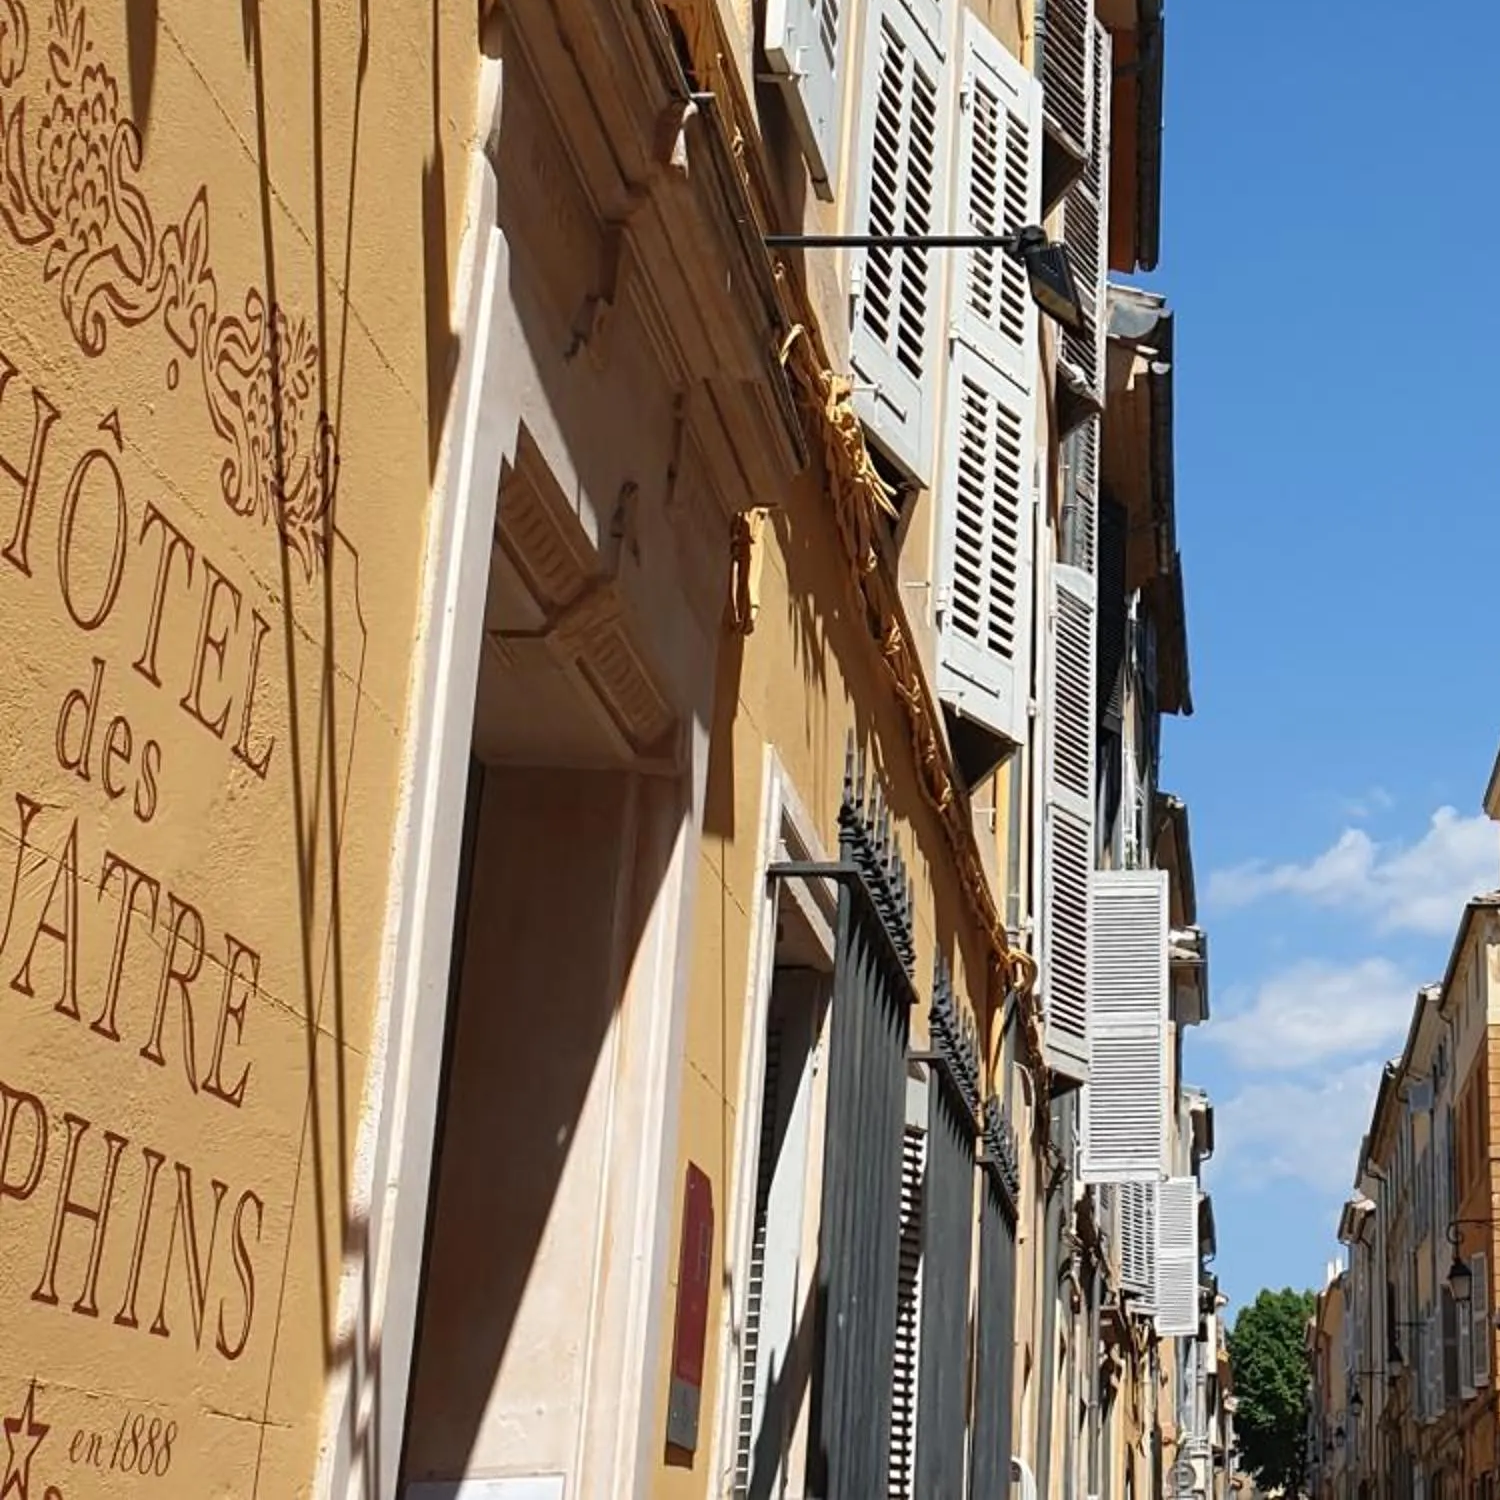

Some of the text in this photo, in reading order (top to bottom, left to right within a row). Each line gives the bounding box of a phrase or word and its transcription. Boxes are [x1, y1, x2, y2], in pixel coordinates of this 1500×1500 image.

[56, 657, 161, 823] des
[69, 1410, 179, 1477] en 1888
